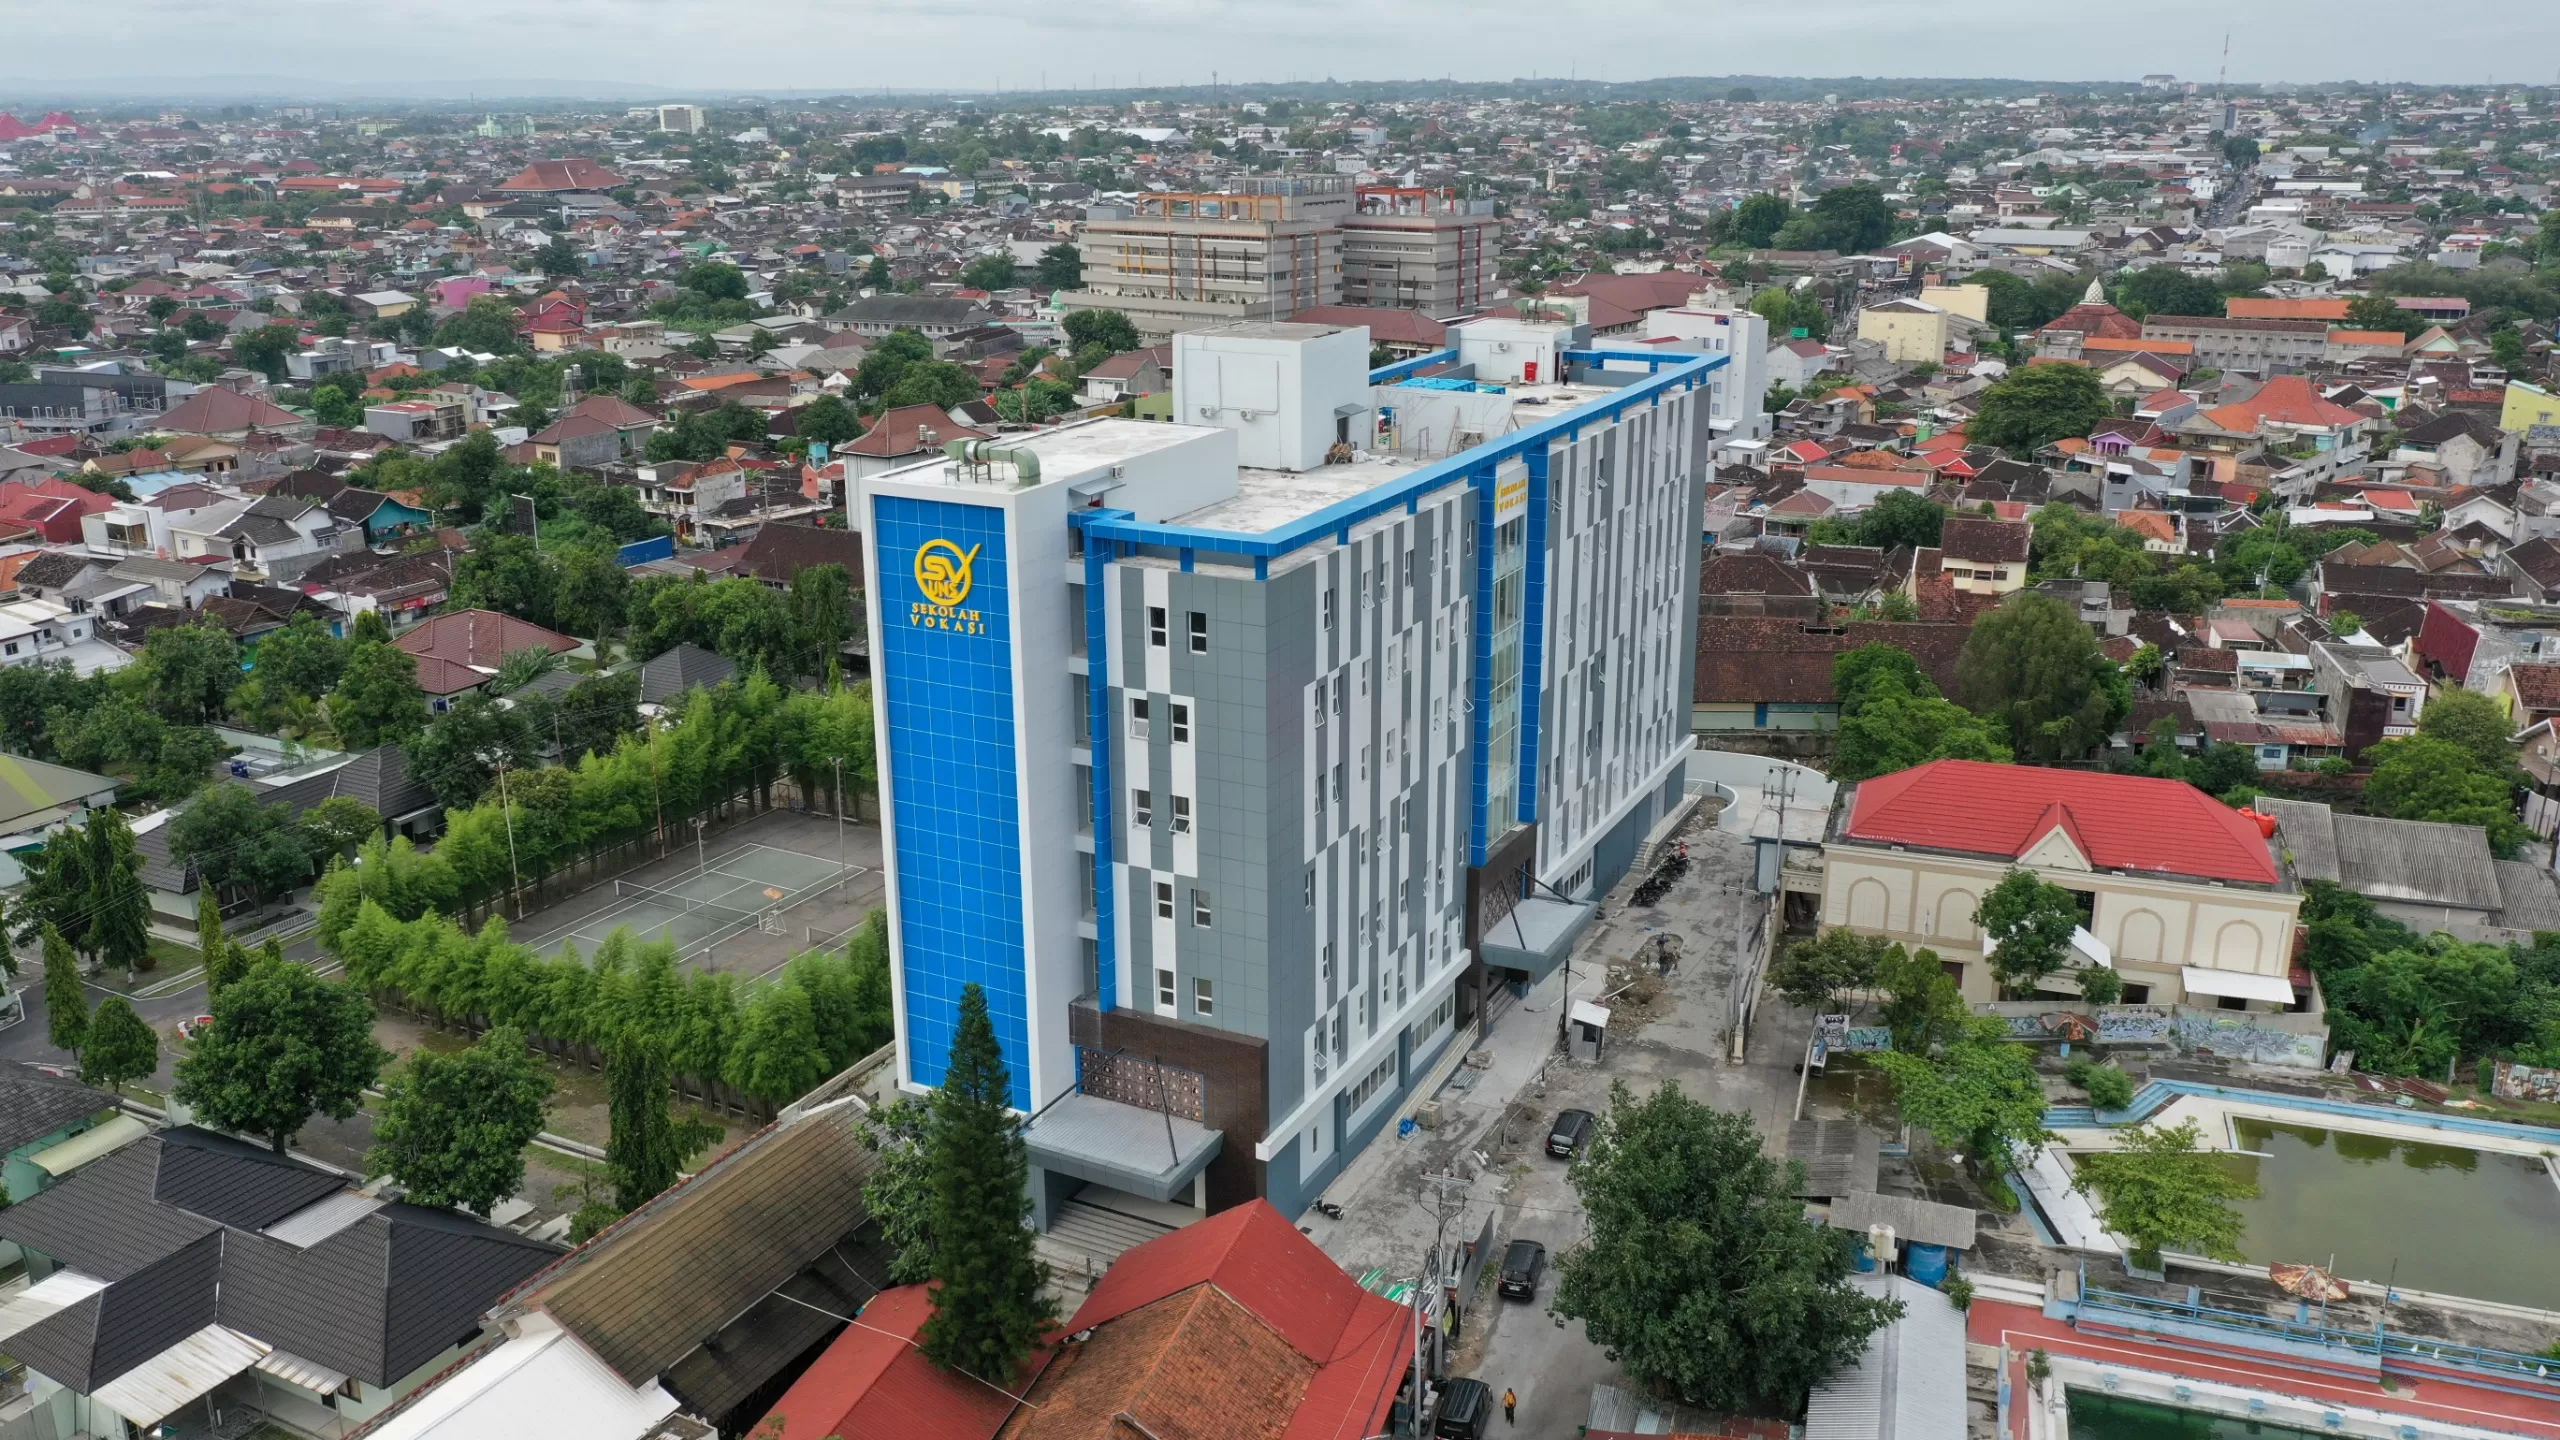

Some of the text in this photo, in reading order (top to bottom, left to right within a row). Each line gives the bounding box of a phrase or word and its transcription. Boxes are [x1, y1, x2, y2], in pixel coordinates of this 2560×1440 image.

[928, 580, 960, 599] UNS
[911, 603, 981, 621] SEKOLAH
[910, 614, 985, 635] VOKASI
